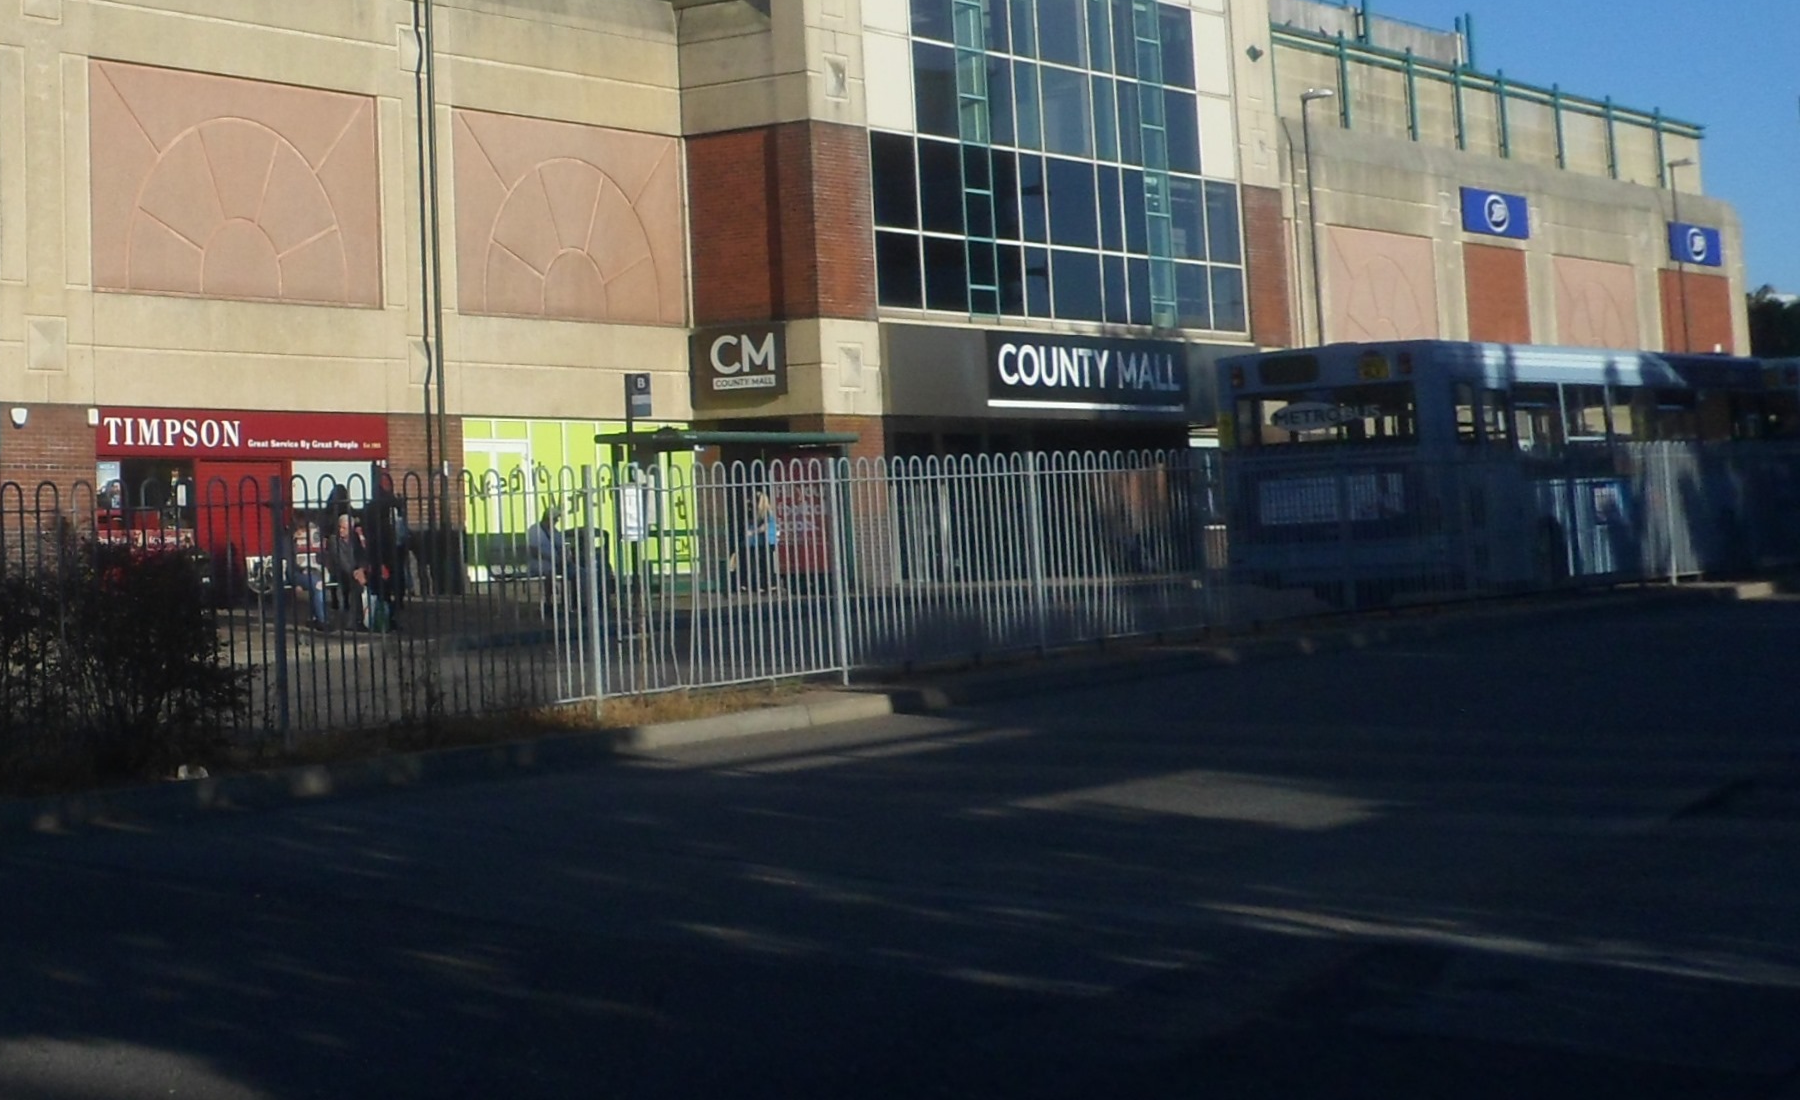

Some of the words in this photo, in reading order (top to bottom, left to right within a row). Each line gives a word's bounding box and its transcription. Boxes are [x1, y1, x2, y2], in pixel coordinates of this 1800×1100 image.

[709, 332, 776, 375] CM
[998, 343, 1110, 388] COUNTY
[1117, 350, 1181, 392] MALL
[636, 377, 646, 389] B
[715, 377, 750, 388] COUNTY
[751, 377, 774, 386] MALL
[1273, 404, 1382, 426] METROBUS
[103, 417, 241, 447] TIMPSON
[247, 439, 269, 448] Great
[270, 439, 299, 448] Service
[300, 440, 310, 450] By
[311, 440, 332, 449] Great
[333, 440, 359, 450] People
